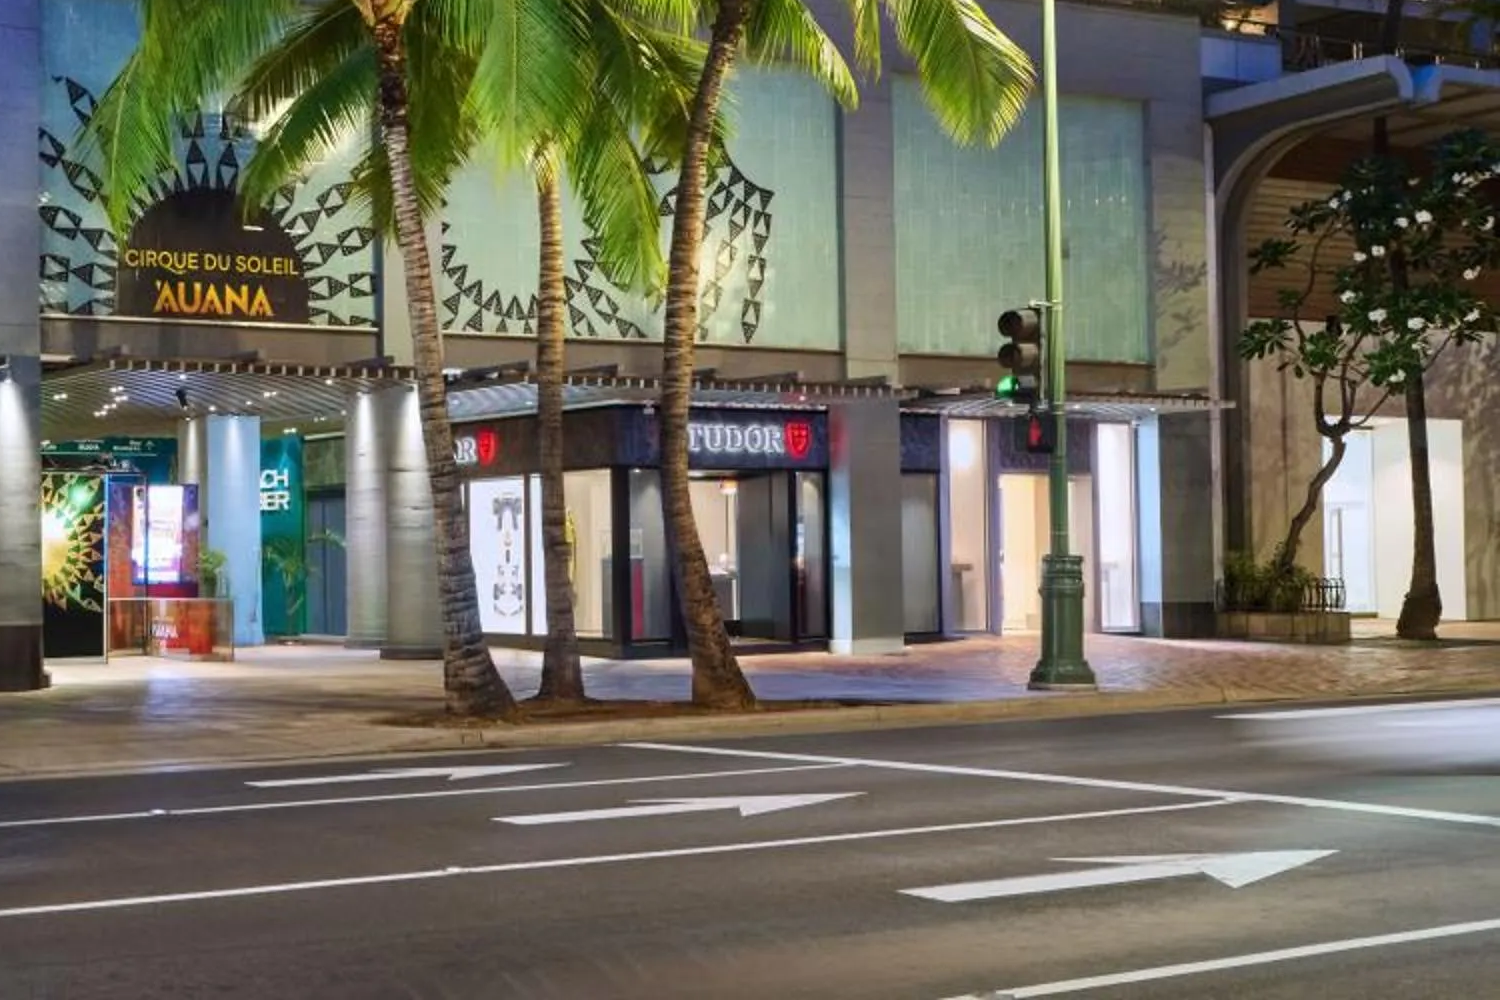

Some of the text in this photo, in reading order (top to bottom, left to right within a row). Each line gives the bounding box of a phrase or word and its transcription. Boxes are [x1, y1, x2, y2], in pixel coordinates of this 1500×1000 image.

[124, 249, 300, 275] CIRQUE DU SOLEIL
[687, 422, 785, 453] TUDOR
